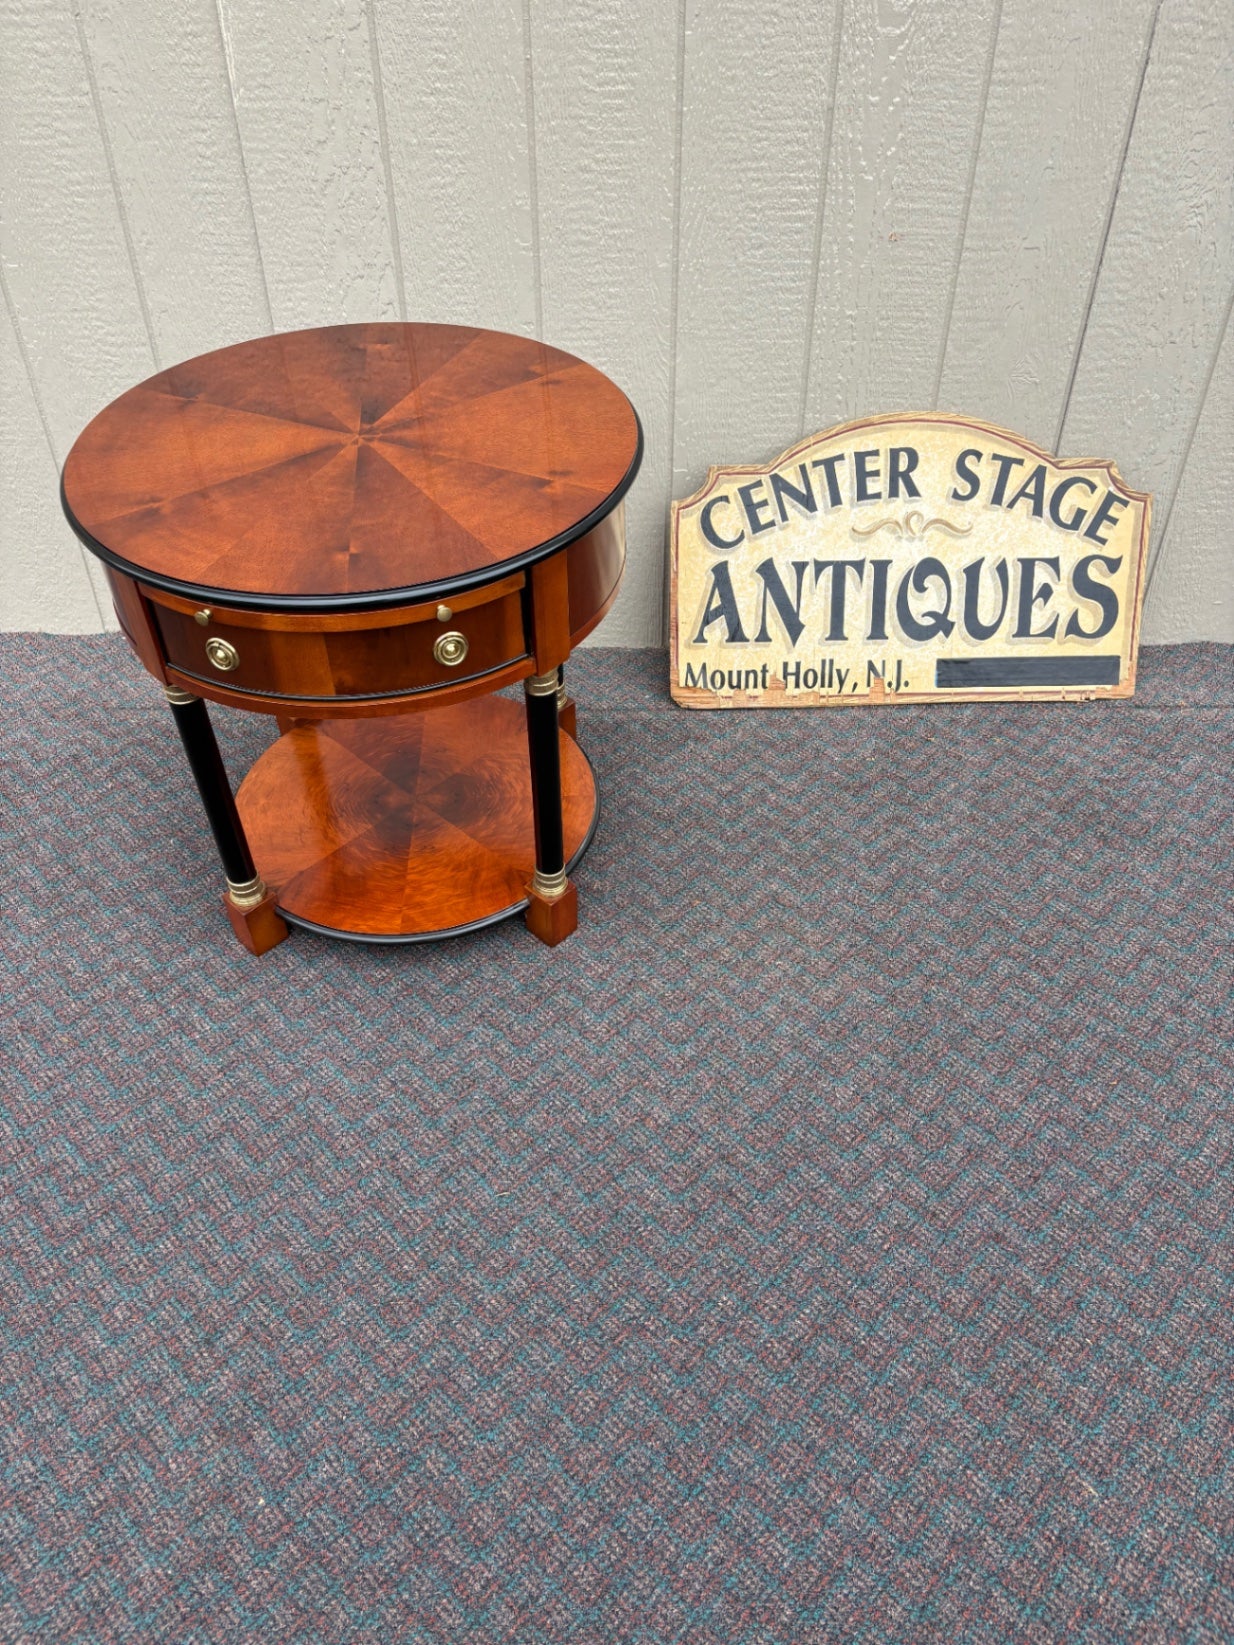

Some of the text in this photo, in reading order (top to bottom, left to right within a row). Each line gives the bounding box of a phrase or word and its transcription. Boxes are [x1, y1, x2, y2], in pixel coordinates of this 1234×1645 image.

[700, 446, 1130, 550] CENTER STAGE
[692, 554, 1124, 648] ANTIQUES
[684, 658, 910, 694] Mount Holly, N.J.
